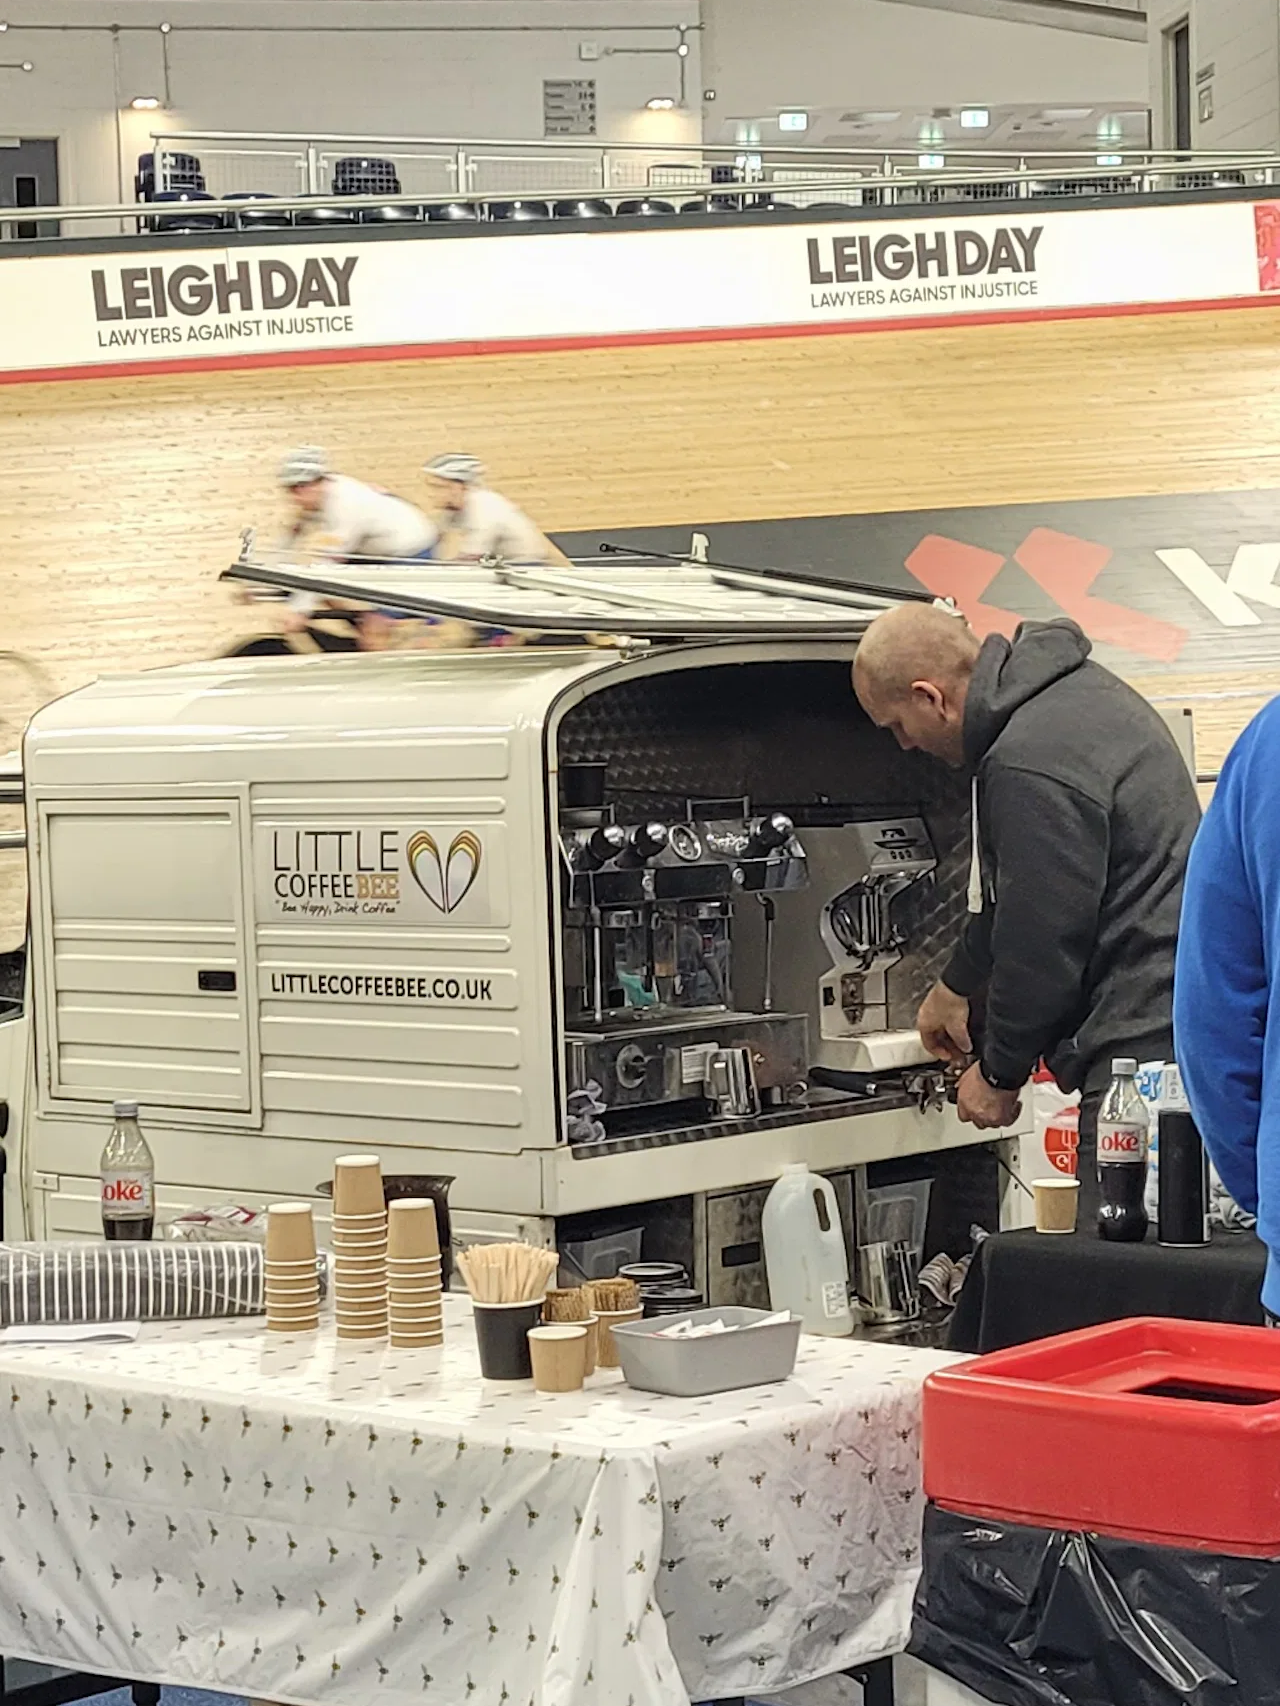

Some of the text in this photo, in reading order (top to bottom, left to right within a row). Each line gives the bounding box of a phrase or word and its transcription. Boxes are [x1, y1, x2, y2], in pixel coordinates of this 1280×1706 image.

[806, 226, 1044, 284] LEIGH DAY
[91, 256, 359, 321] LEIGH DAY
[811, 280, 1038, 308] LAWYERS AGAINST INJUSTICE
[97, 315, 354, 348] LAWYERS AGAINST INJUSTICE
[274, 831, 399, 872] LITTLE
[271, 973, 493, 1001] LITTLECOFFEEBEE.CO.UK
[1098, 1129, 1139, 1153] oke
[101, 1179, 144, 1201] oke
